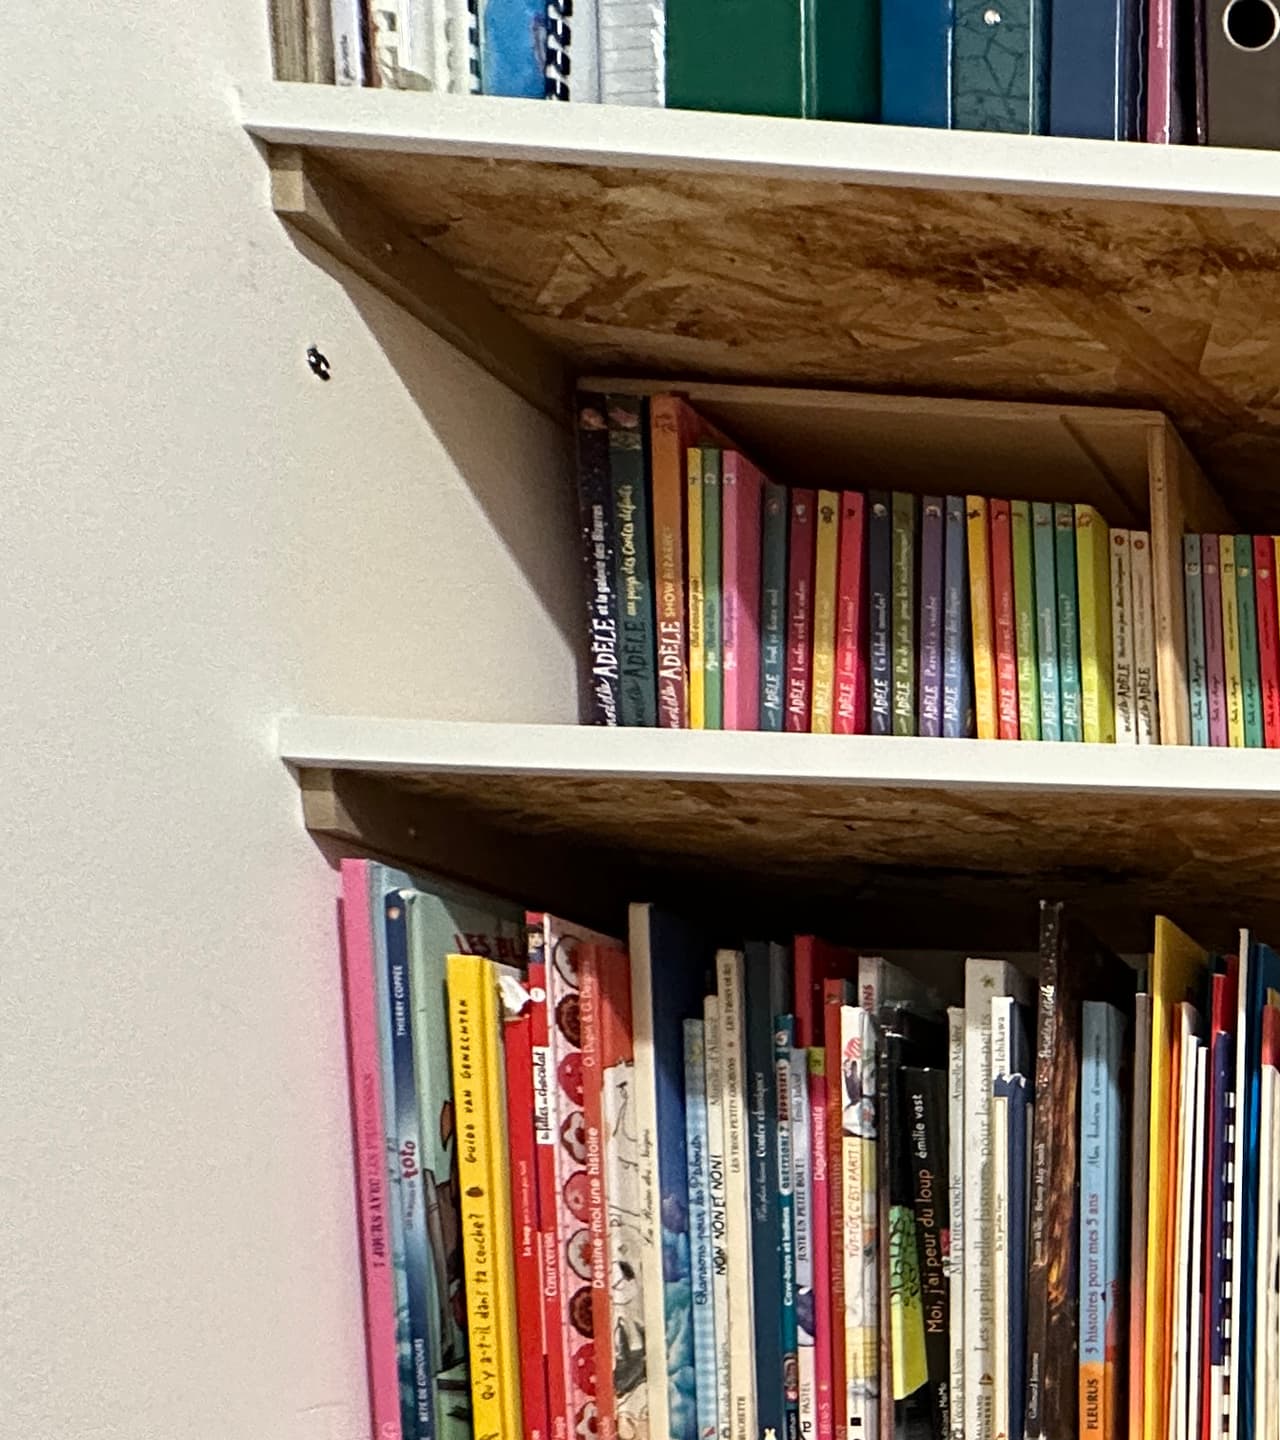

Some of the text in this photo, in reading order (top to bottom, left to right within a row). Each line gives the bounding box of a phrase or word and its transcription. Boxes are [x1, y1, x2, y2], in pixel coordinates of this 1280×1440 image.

[620, 556, 636, 575] des
[590, 617, 621, 679] ADÈLE
[654, 581, 682, 681] ADÈLE SHOW
[911, 1093, 928, 1159] émilie vast
[399, 1140, 419, 1179] toto
[587, 1127, 601, 1175] histoire
[590, 1178, 602, 1205] une
[949, 1174, 962, 1223] couche
[522, 1226, 534, 1246] loup
[712, 1194, 727, 1276] NON NON ET
[915, 1168, 945, 1334] Moi, j'ai peur du loup
[474, 1269, 488, 1284] ta
[1084, 1192, 1101, 1355] 5 histoires pour mes 5 ans
[473, 1290, 490, 1319] dans
[973, 1327, 990, 1352] Les
[1085, 1379, 1099, 1431] FLEURUS
